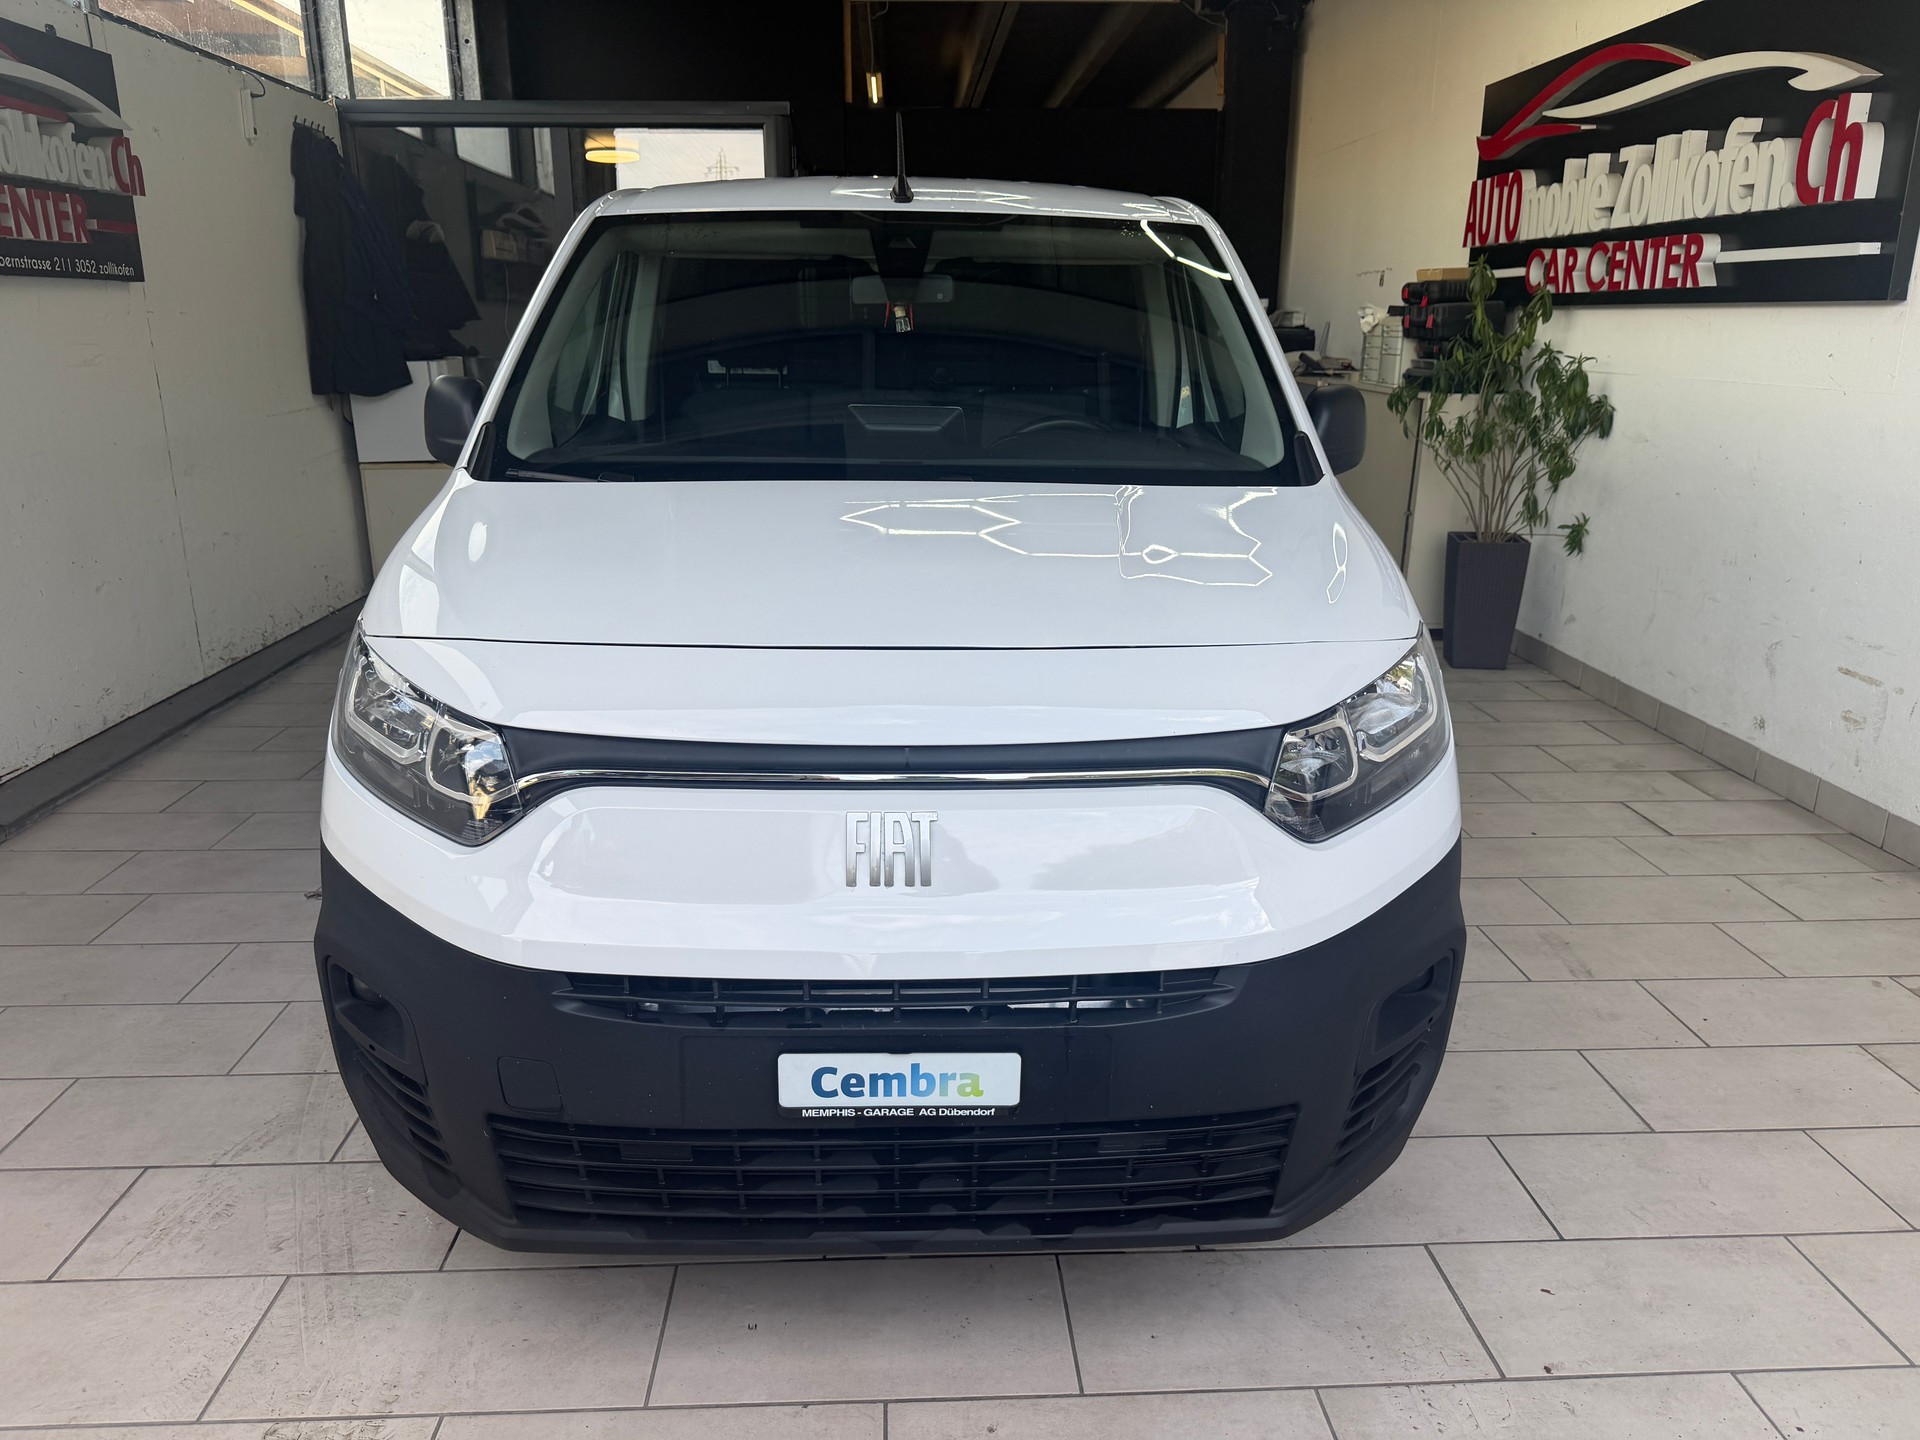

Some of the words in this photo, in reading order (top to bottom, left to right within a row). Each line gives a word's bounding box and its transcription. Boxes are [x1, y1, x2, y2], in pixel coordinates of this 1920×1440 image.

[0, 109, 146, 197] ollikofen.Ch
[54, 257, 72, 272] 211
[75, 258, 97, 274] 3052
[99, 261, 135, 276] zollikofen
[1525, 246, 1582, 295] CAR
[1585, 232, 1710, 292] CENTER
[845, 811, 938, 887] FIAT
[811, 1063, 984, 1099] Cembra
[802, 1108, 856, 1117] MEMPHIS
[863, 1108, 914, 1117] GARAGE
[919, 1108, 937, 1117] AG
[938, 1106, 996, 1117] Dübendorf
